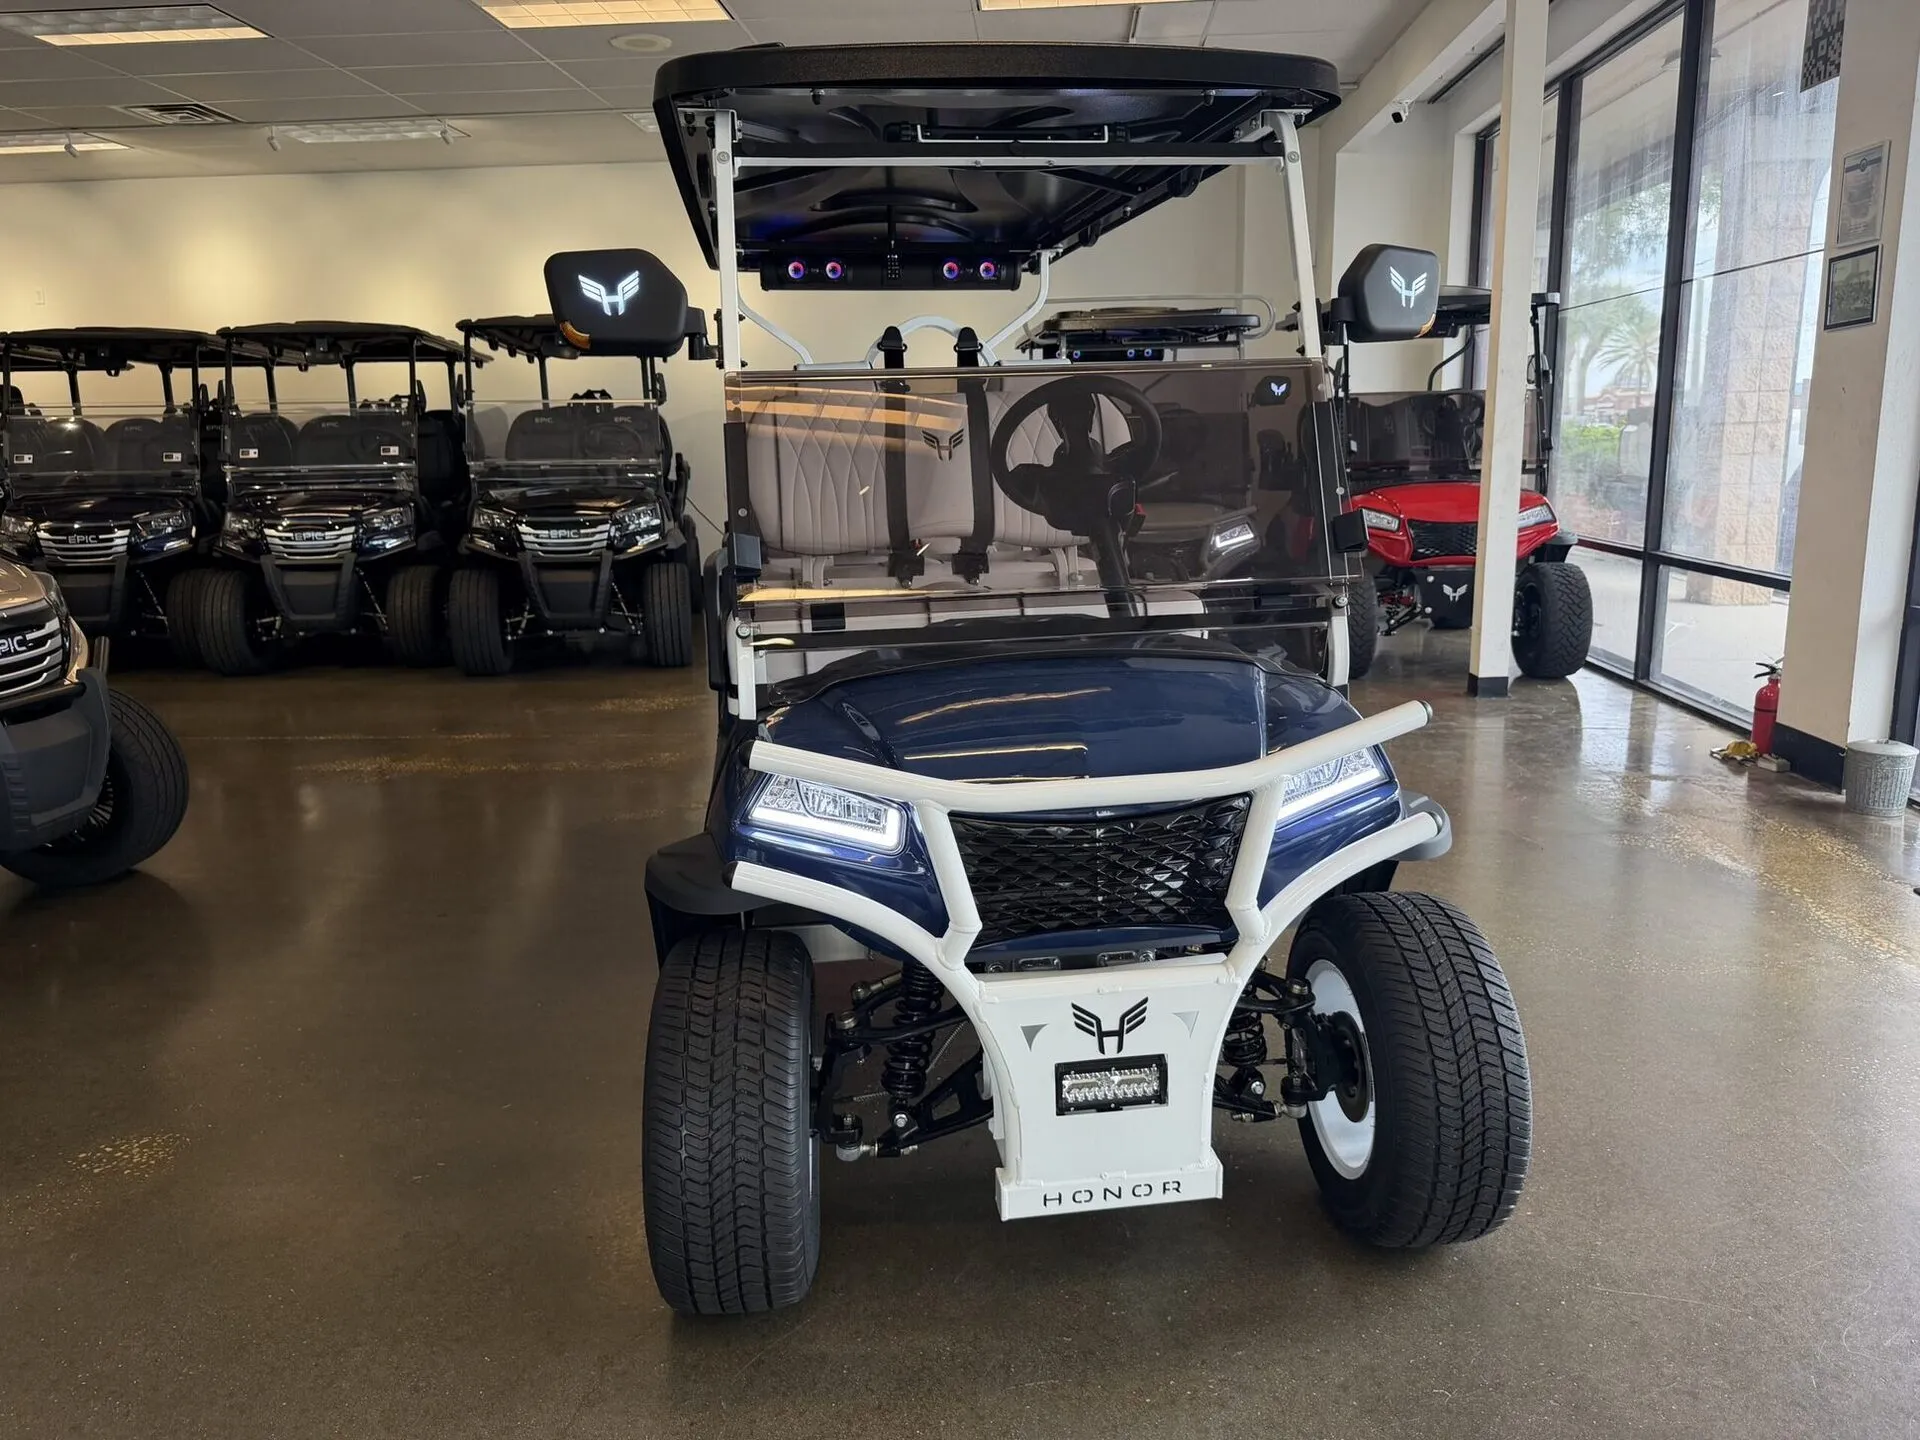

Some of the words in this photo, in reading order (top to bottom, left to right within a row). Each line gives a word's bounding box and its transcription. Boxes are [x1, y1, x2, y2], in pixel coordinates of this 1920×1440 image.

[68, 533, 98, 544] EPIC
[294, 532, 325, 541] EPIC
[549, 529, 580, 539] EPIC
[0, 635, 27, 656] PIC
[1042, 1180, 1182, 1208] HONOR
